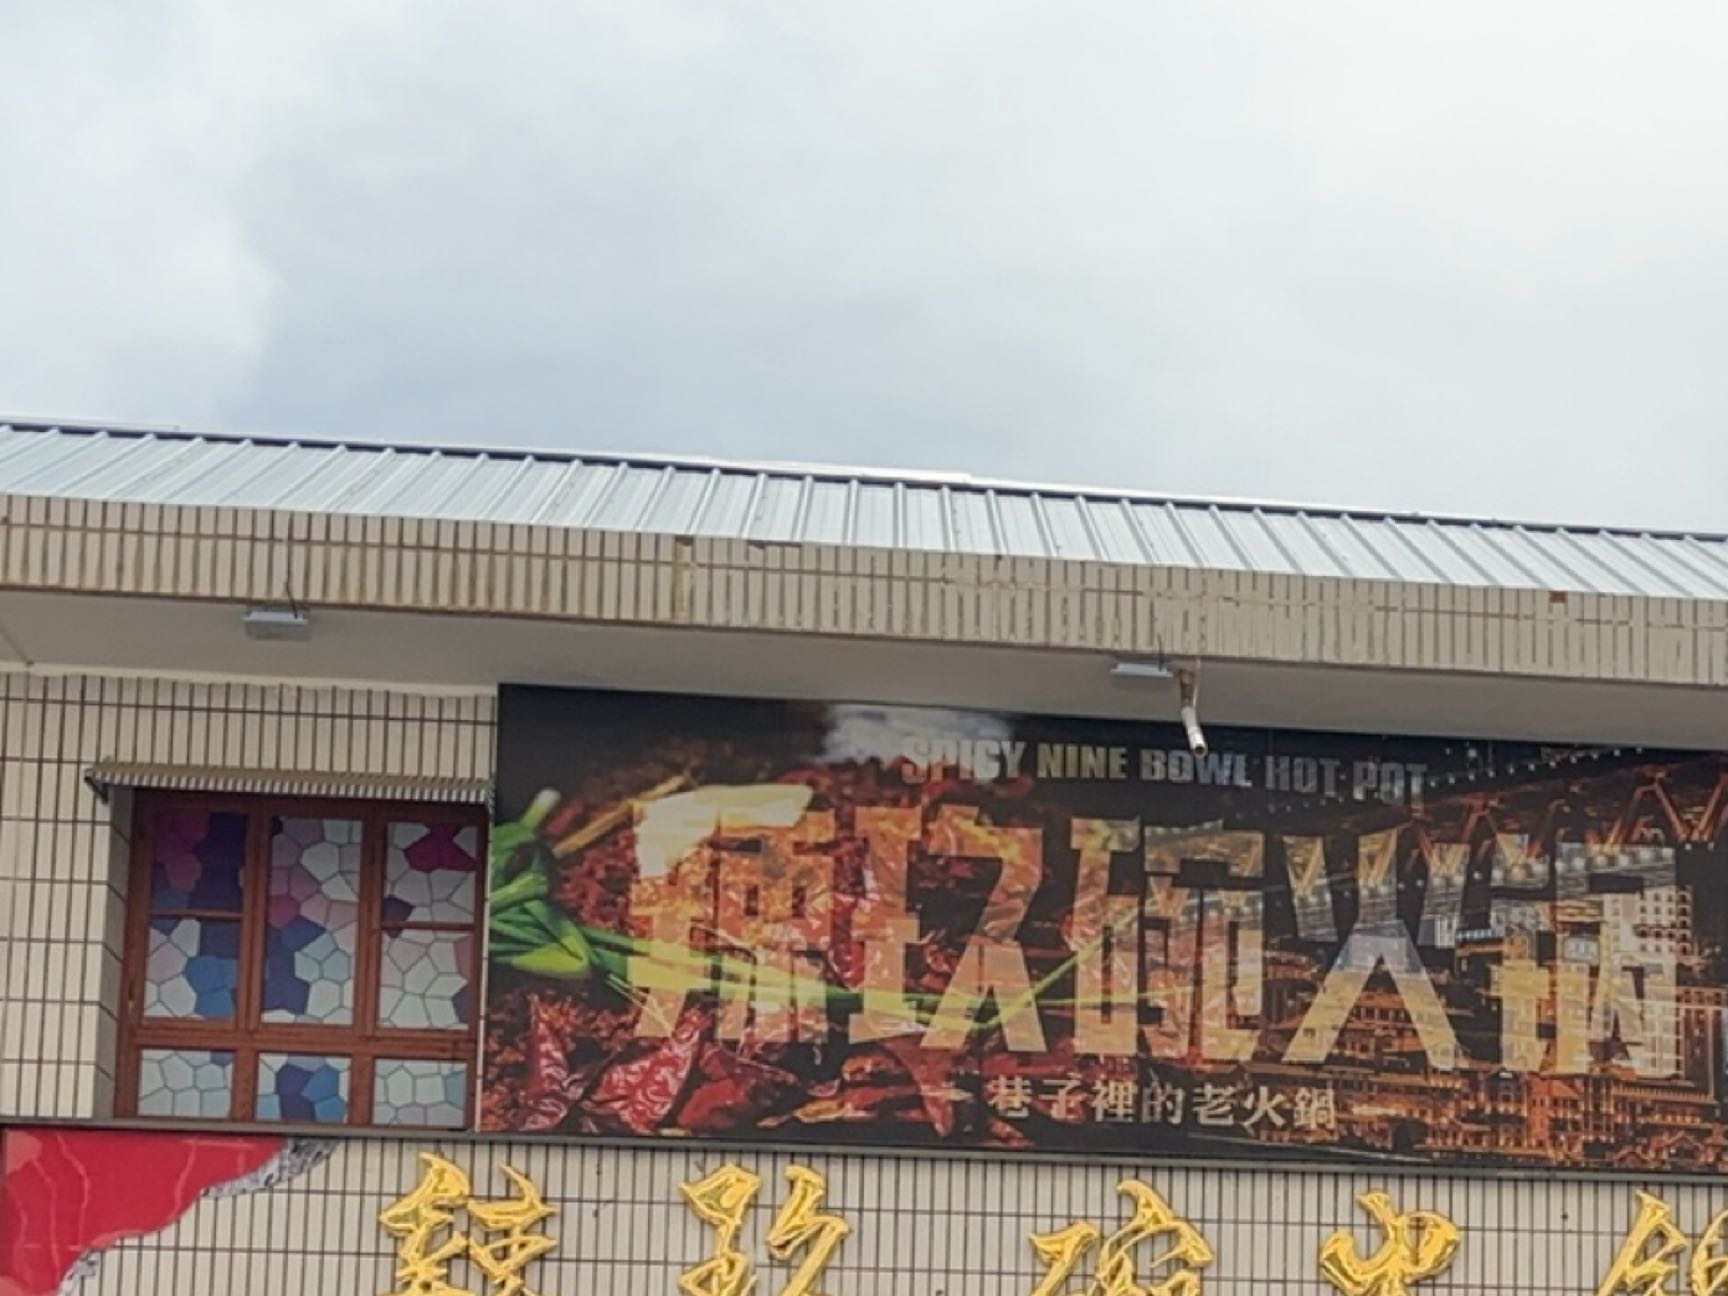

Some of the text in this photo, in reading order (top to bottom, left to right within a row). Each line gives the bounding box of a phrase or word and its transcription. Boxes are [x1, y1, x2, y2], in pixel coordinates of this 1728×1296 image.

[902, 738, 1429, 804] SPICY NINE BOWL HOT POT
